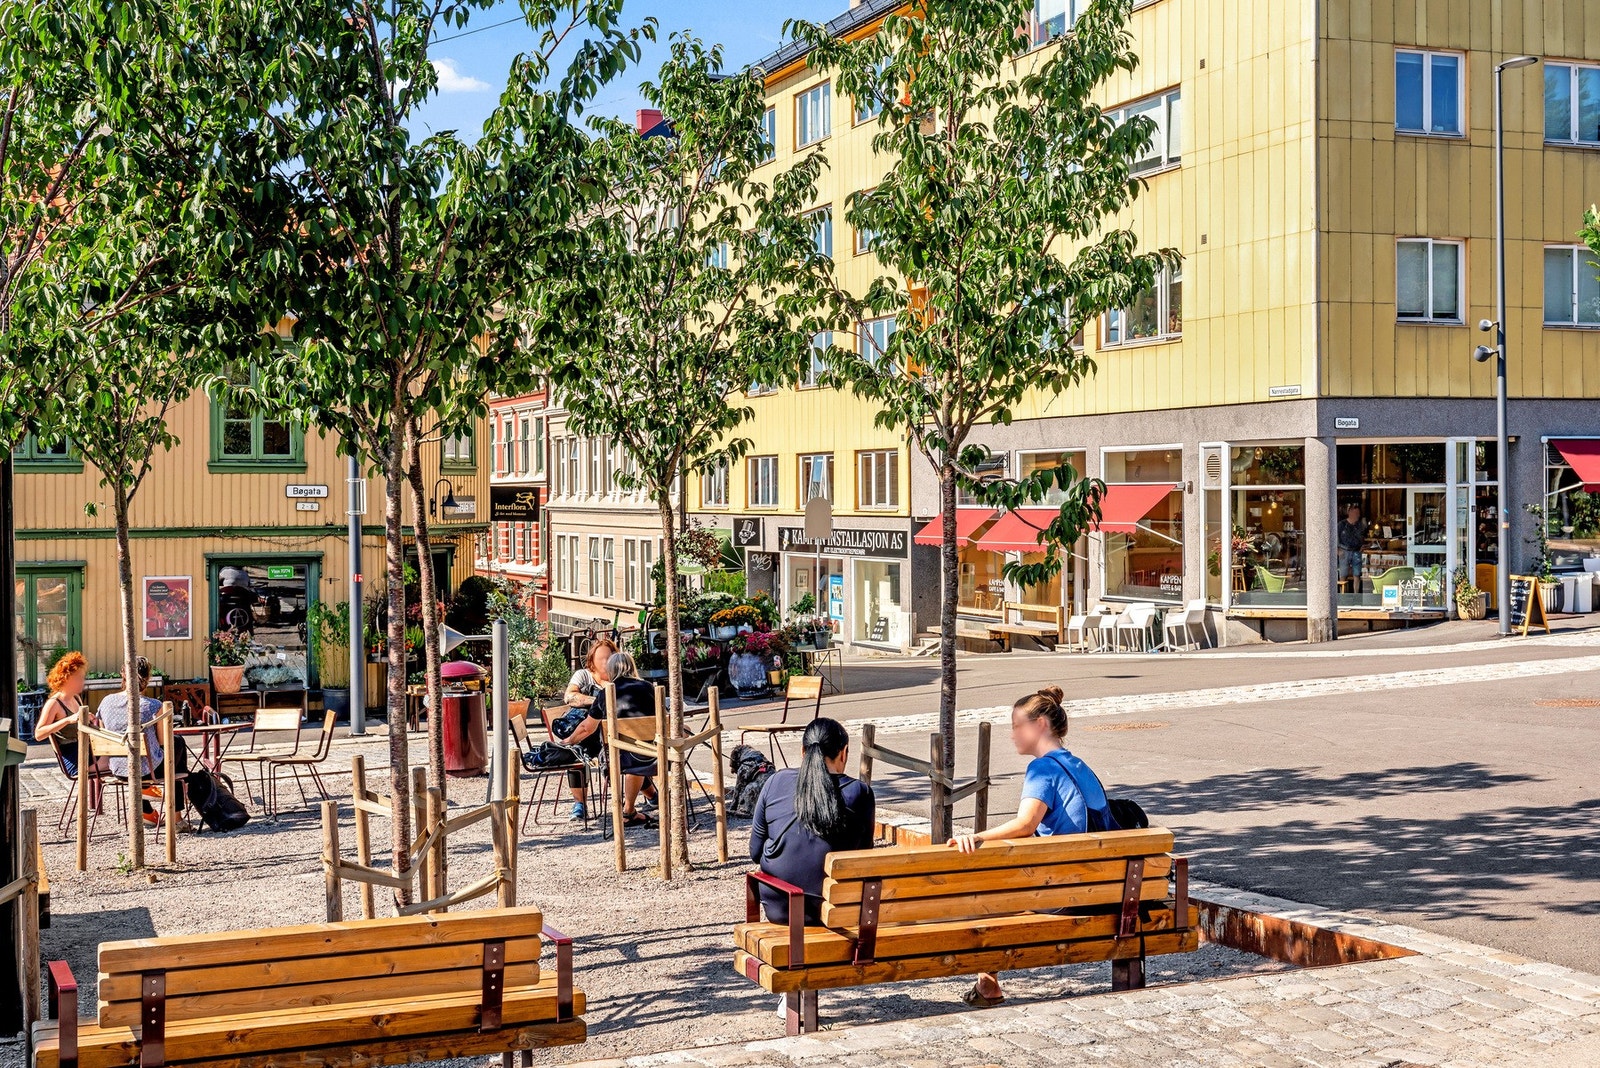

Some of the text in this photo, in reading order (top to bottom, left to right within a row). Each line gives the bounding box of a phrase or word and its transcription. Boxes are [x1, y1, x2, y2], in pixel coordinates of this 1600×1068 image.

[1338, 419, 1357, 427] Bøgata
[292, 487, 321, 496] Bøgata
[494, 502, 527, 511] Interflora
[792, 529, 903, 551] KAMN INSTALLASJON AS
[1160, 575, 1182, 585] KAMPEN
